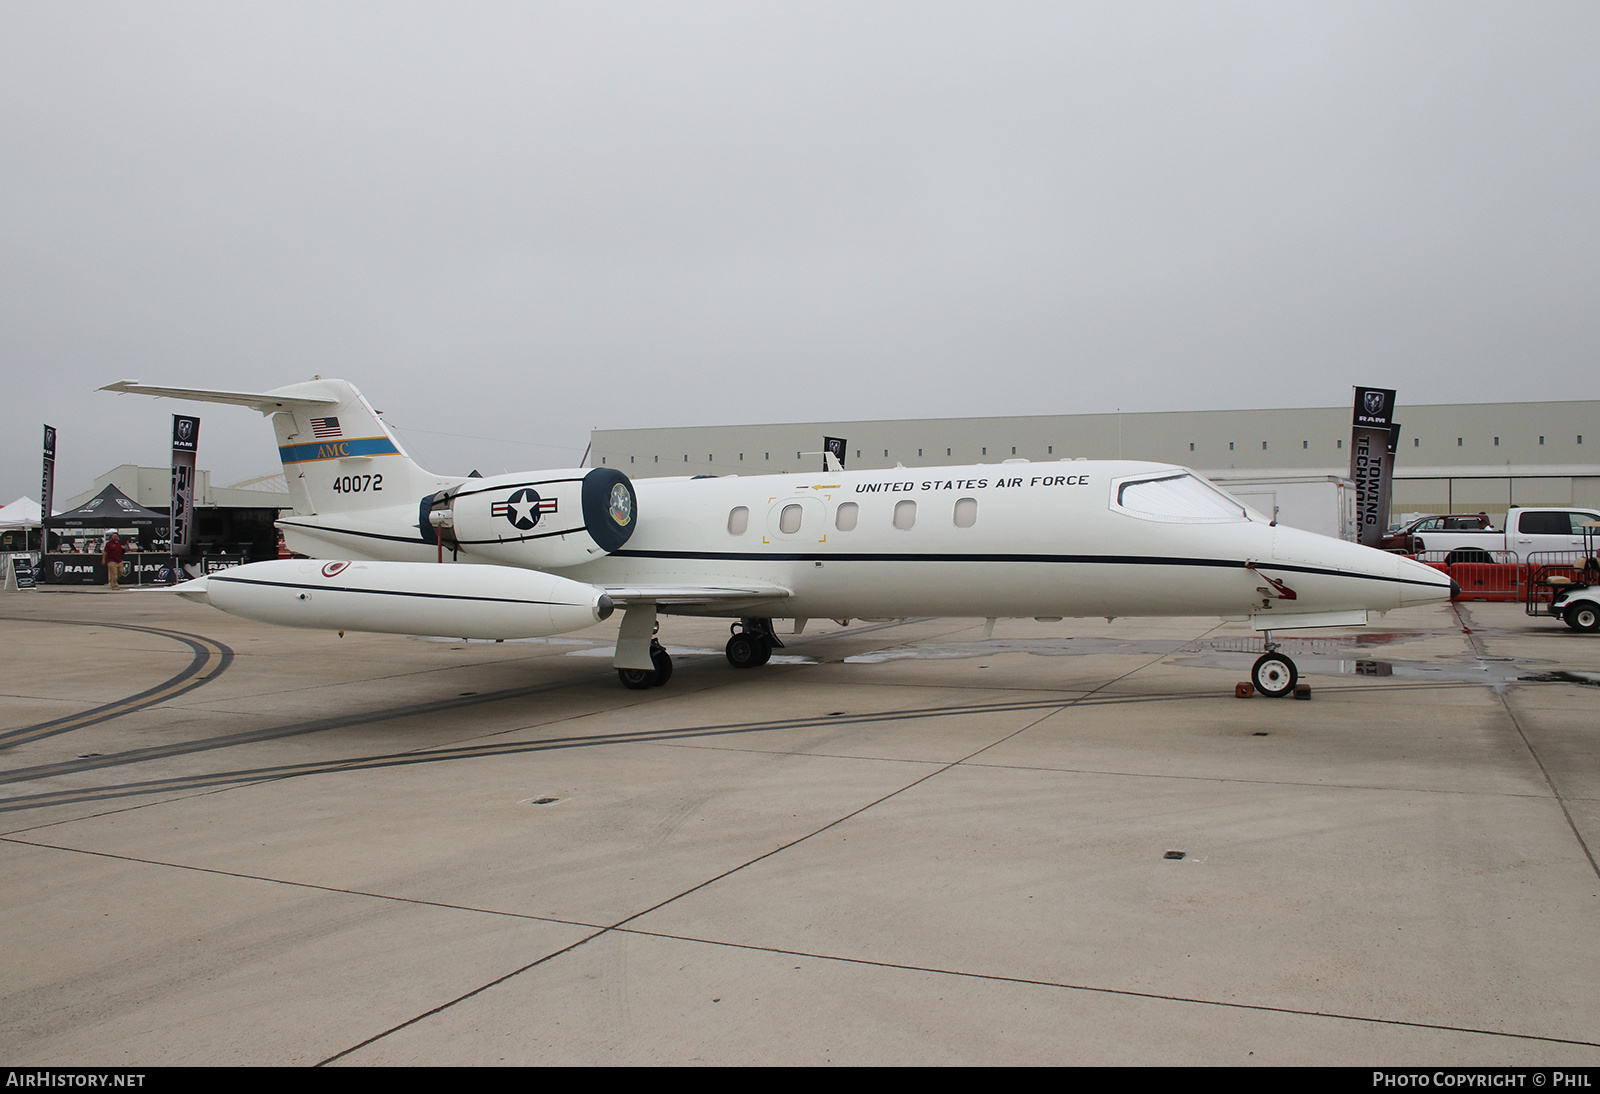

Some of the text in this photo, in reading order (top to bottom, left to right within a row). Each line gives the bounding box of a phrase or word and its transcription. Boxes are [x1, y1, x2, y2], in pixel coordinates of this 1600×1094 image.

[1358, 415, 1386, 423] RAM
[318, 443, 350, 458] AMC
[333, 474, 382, 493] 40072
[855, 475, 1090, 493] UNITED STATES AIR FORCE
[1365, 456, 1382, 526] TOWING
[173, 465, 189, 545] RAM
[64, 565, 94, 573] RAM
